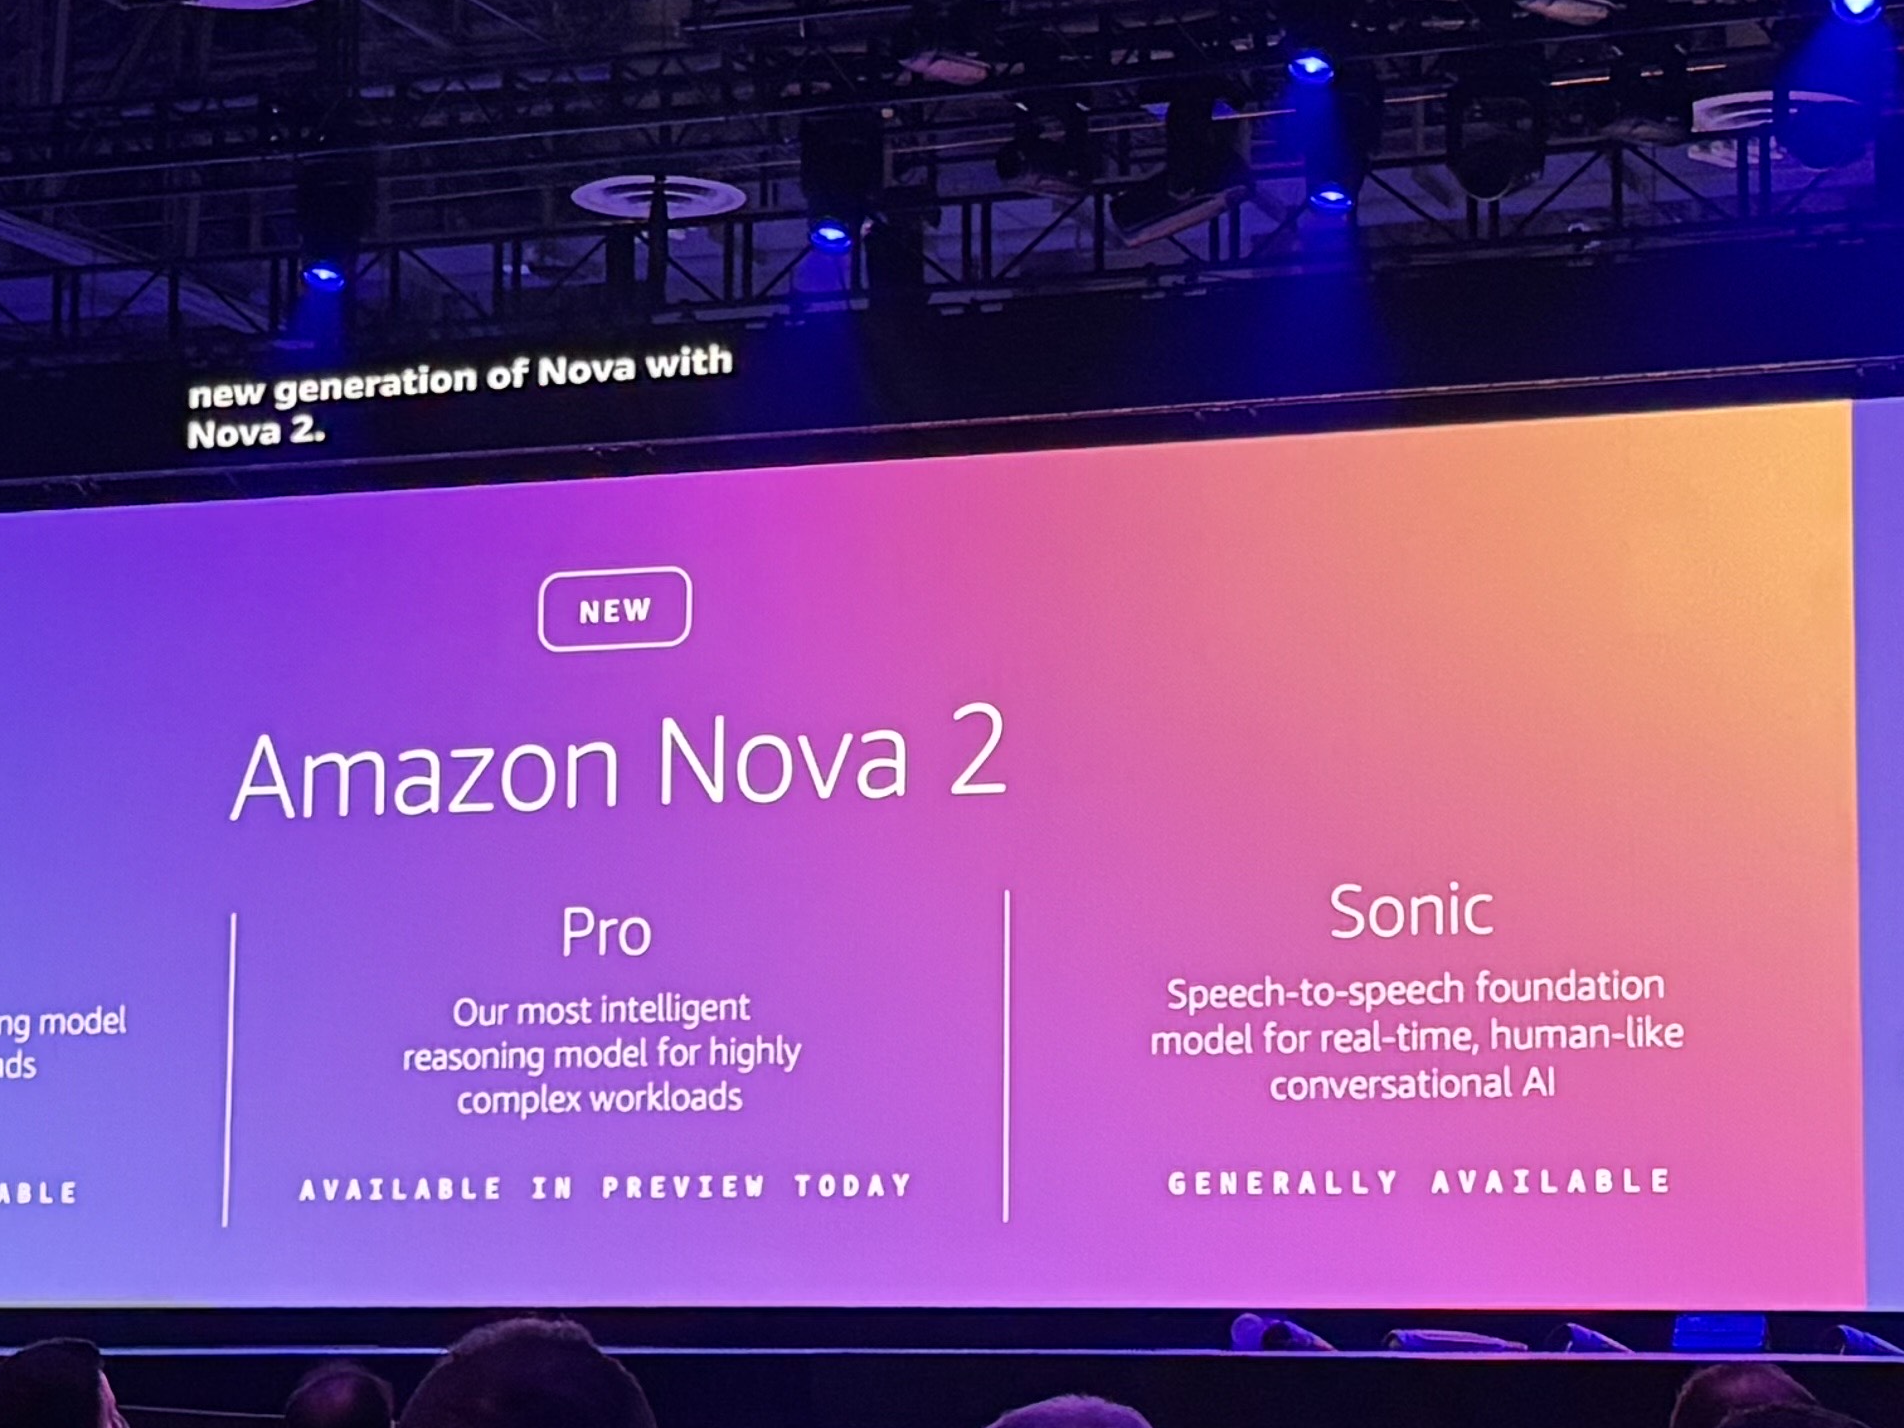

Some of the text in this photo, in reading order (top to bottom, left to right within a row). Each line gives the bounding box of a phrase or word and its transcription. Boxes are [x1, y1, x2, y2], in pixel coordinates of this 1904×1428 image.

[188, 343, 733, 411] new generation of Nova with
[187, 413, 326, 450] Nova 2.
[579, 597, 651, 624] NEW
[229, 702, 1007, 821] Amazon Nova 2
[1330, 881, 1494, 939] Sonic
[563, 906, 652, 957] Pro
[453, 992, 751, 1030] Our most intelligent
[1167, 968, 1665, 1016] Speech-to-speech foundation
[39, 1004, 127, 1036] model
[1151, 1014, 1685, 1056] model for real-time, human-like
[403, 1034, 802, 1077] reasoning model for highly
[457, 1080, 743, 1121] complex workloads
[1270, 1065, 1555, 1101] conversational AI
[298, 1173, 910, 1202] AVAILABLE IN PREVIEW TODAY
[1168, 1168, 1668, 1196] GENERALLY AVAILABLE
